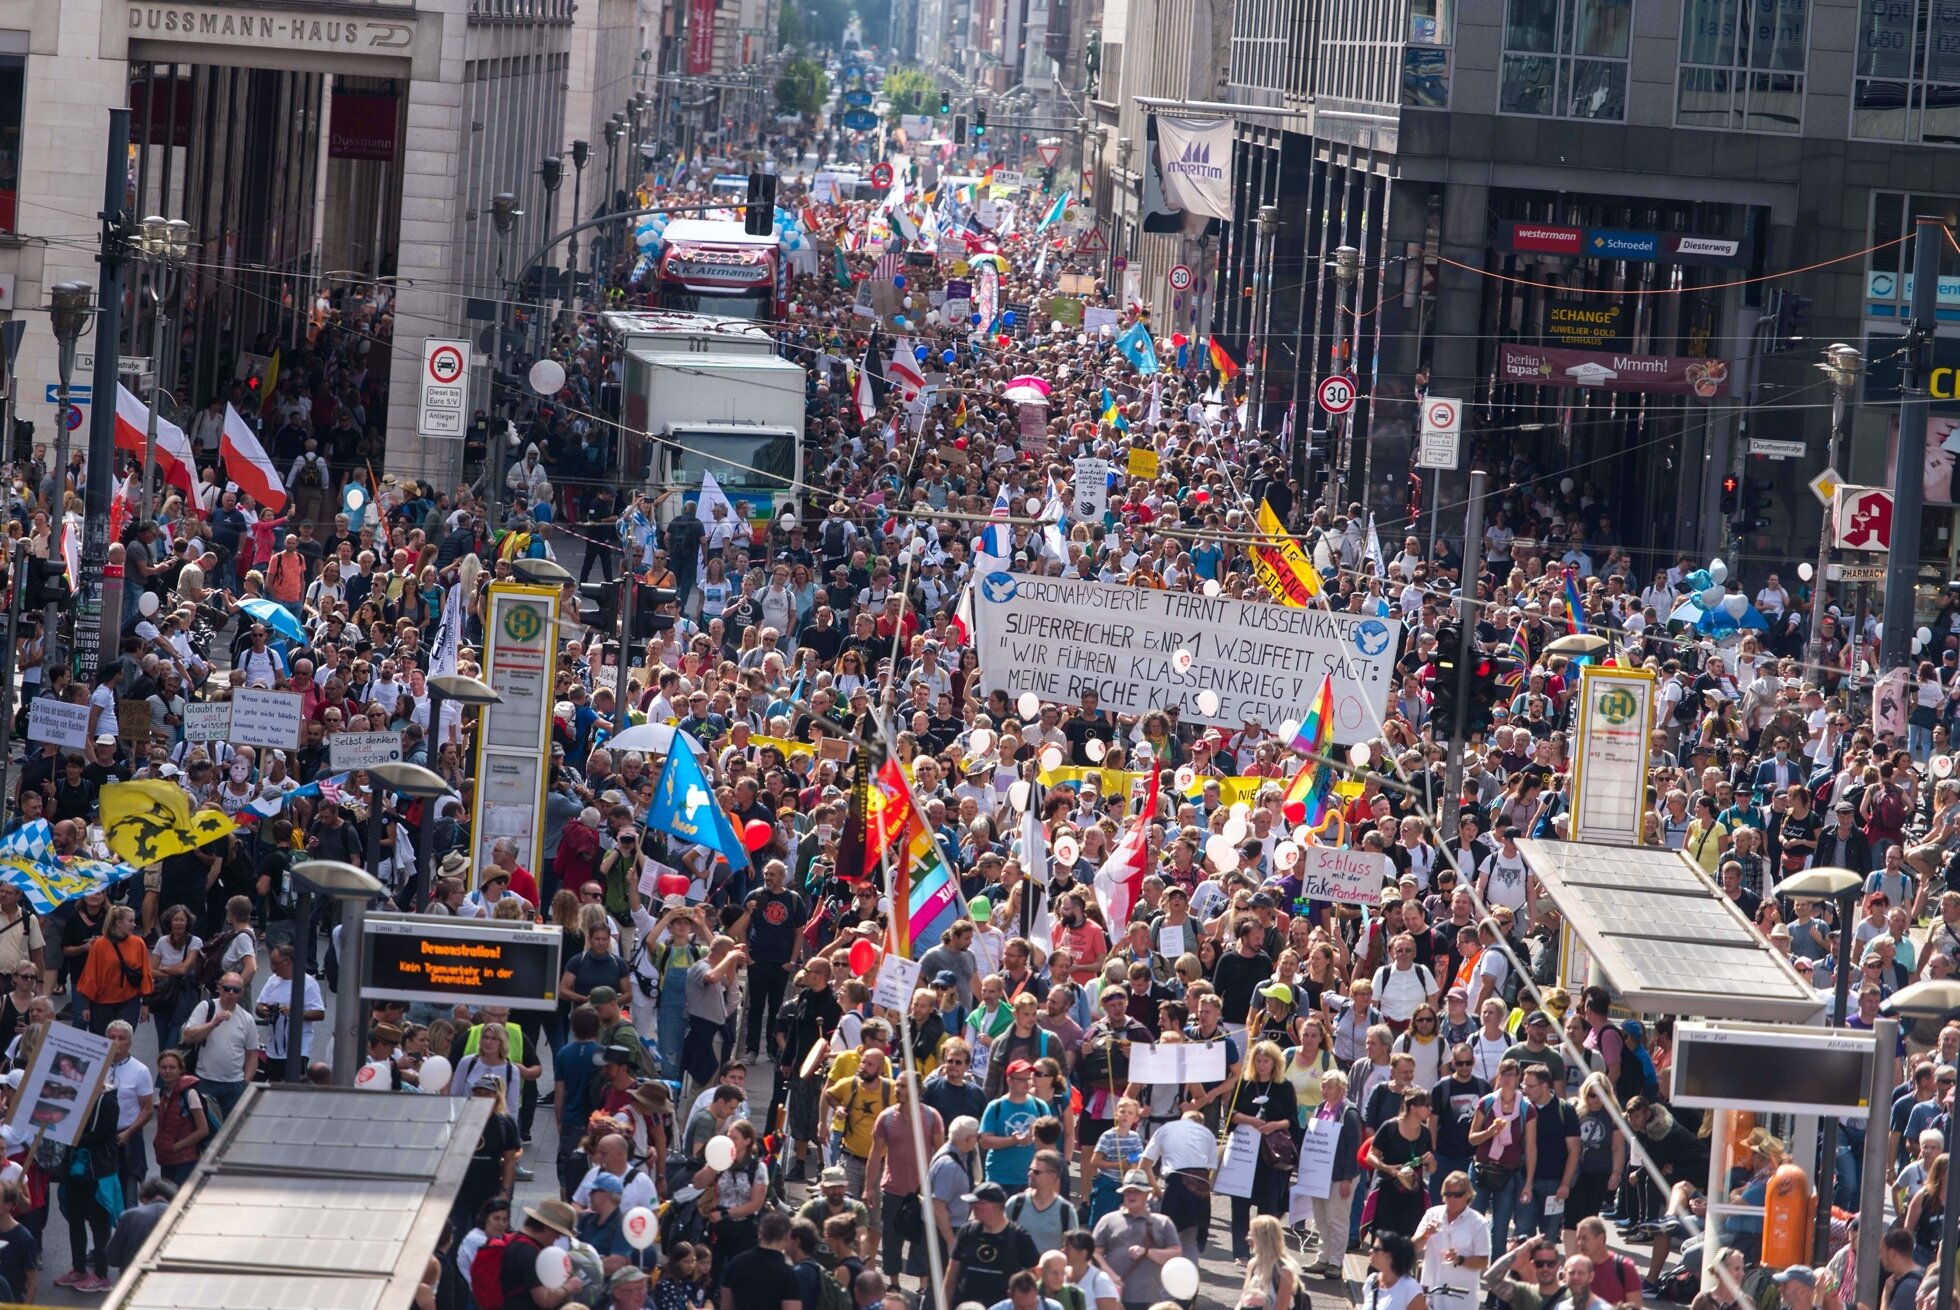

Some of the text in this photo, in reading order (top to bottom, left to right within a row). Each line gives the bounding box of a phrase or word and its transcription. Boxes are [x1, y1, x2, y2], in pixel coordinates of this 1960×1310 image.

[128, 7, 358, 44] DUSSMANN-HAUS
[1518, 229, 1577, 241] westermann
[1607, 239, 1653, 251] Schroedel
[1683, 240, 1732, 254] Diesterweg
[696, 267, 754, 278] Altmann
[1173, 271, 1188, 284] 30
[1507, 352, 1539, 366] berlin
[1613, 356, 1668, 373] Mmmh!
[1507, 364, 1539, 376] tapas
[429, 388, 448, 396] Diesel
[1326, 386, 1348, 403] 30
[429, 412, 456, 421] Anlieger
[436, 421, 448, 429] frei
[1753, 441, 1802, 453] Dorotheenstraße
[1841, 568, 1885, 578] PHARMACY
[1163, 593, 1230, 624] TARNT
[76, 631, 100, 640] RUHIG
[1006, 612, 1135, 649] SUPERREICHER
[1214, 633, 1315, 673] W.BUFFETT
[1057, 645, 1117, 674] FÜHREN
[186, 704, 213, 714] Glaubt
[1148, 686, 1231, 720] KLASE
[187, 730, 229, 739] alles bess
[334, 735, 398, 747] Selbst denken
[353, 744, 373, 753] statt
[337, 752, 389, 766] tagesschau
[1318, 852, 1372, 876] Schluss
[1331, 871, 1362, 882] mit der
[512, 934, 540, 942] Abfahrt
[420, 940, 501, 959] Demonstration!
[400, 961, 421, 972] Kein
[483, 967, 494, 977] in
[496, 968, 513, 979] der
[1690, 1032, 1727, 1041] Linie Ziel
[1827, 1040, 1863, 1050] Abfahrt in
